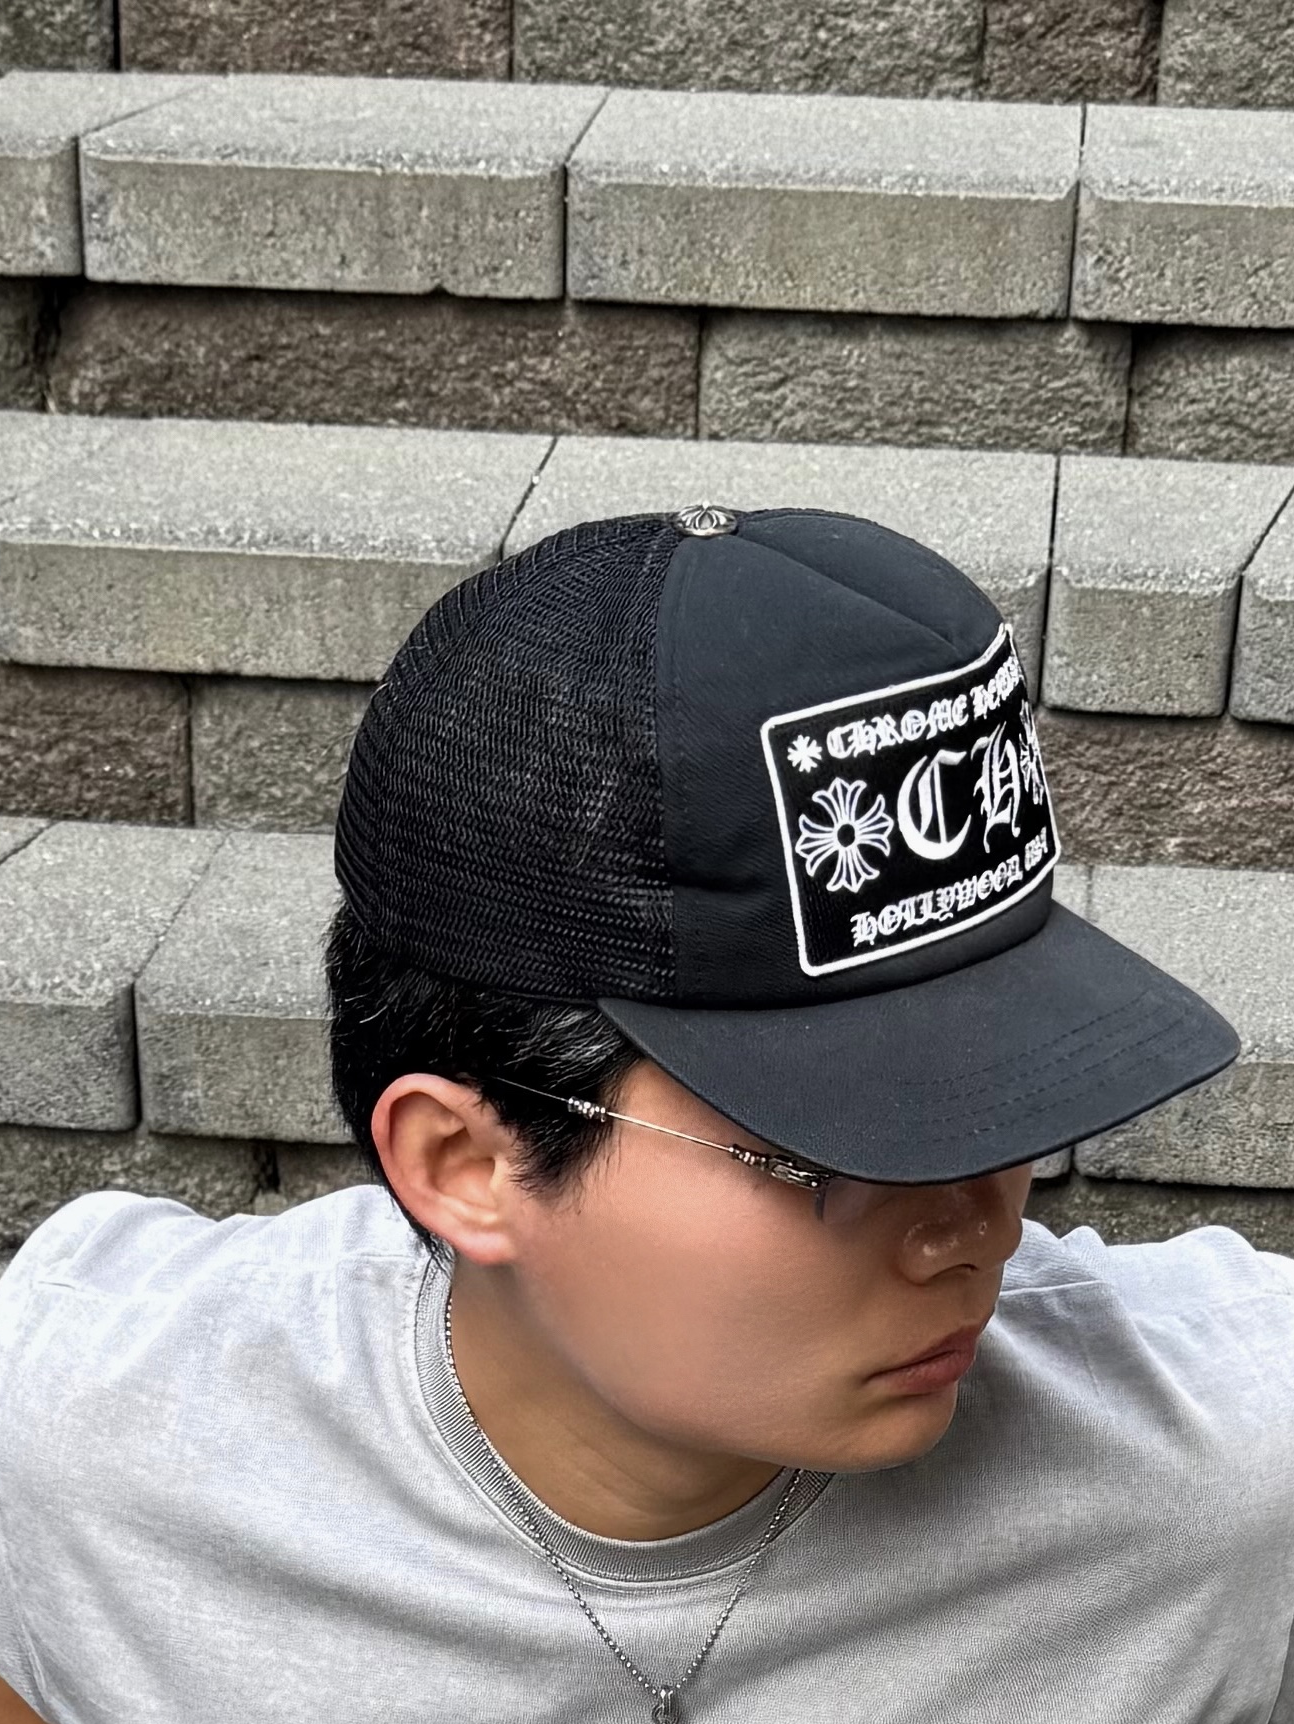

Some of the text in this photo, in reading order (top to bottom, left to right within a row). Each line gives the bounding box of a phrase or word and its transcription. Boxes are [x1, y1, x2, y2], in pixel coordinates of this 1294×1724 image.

[826, 695, 969, 760] CHROME
[897, 721, 1022, 860] CH
[850, 854, 1023, 947] HOLLYWOOD
